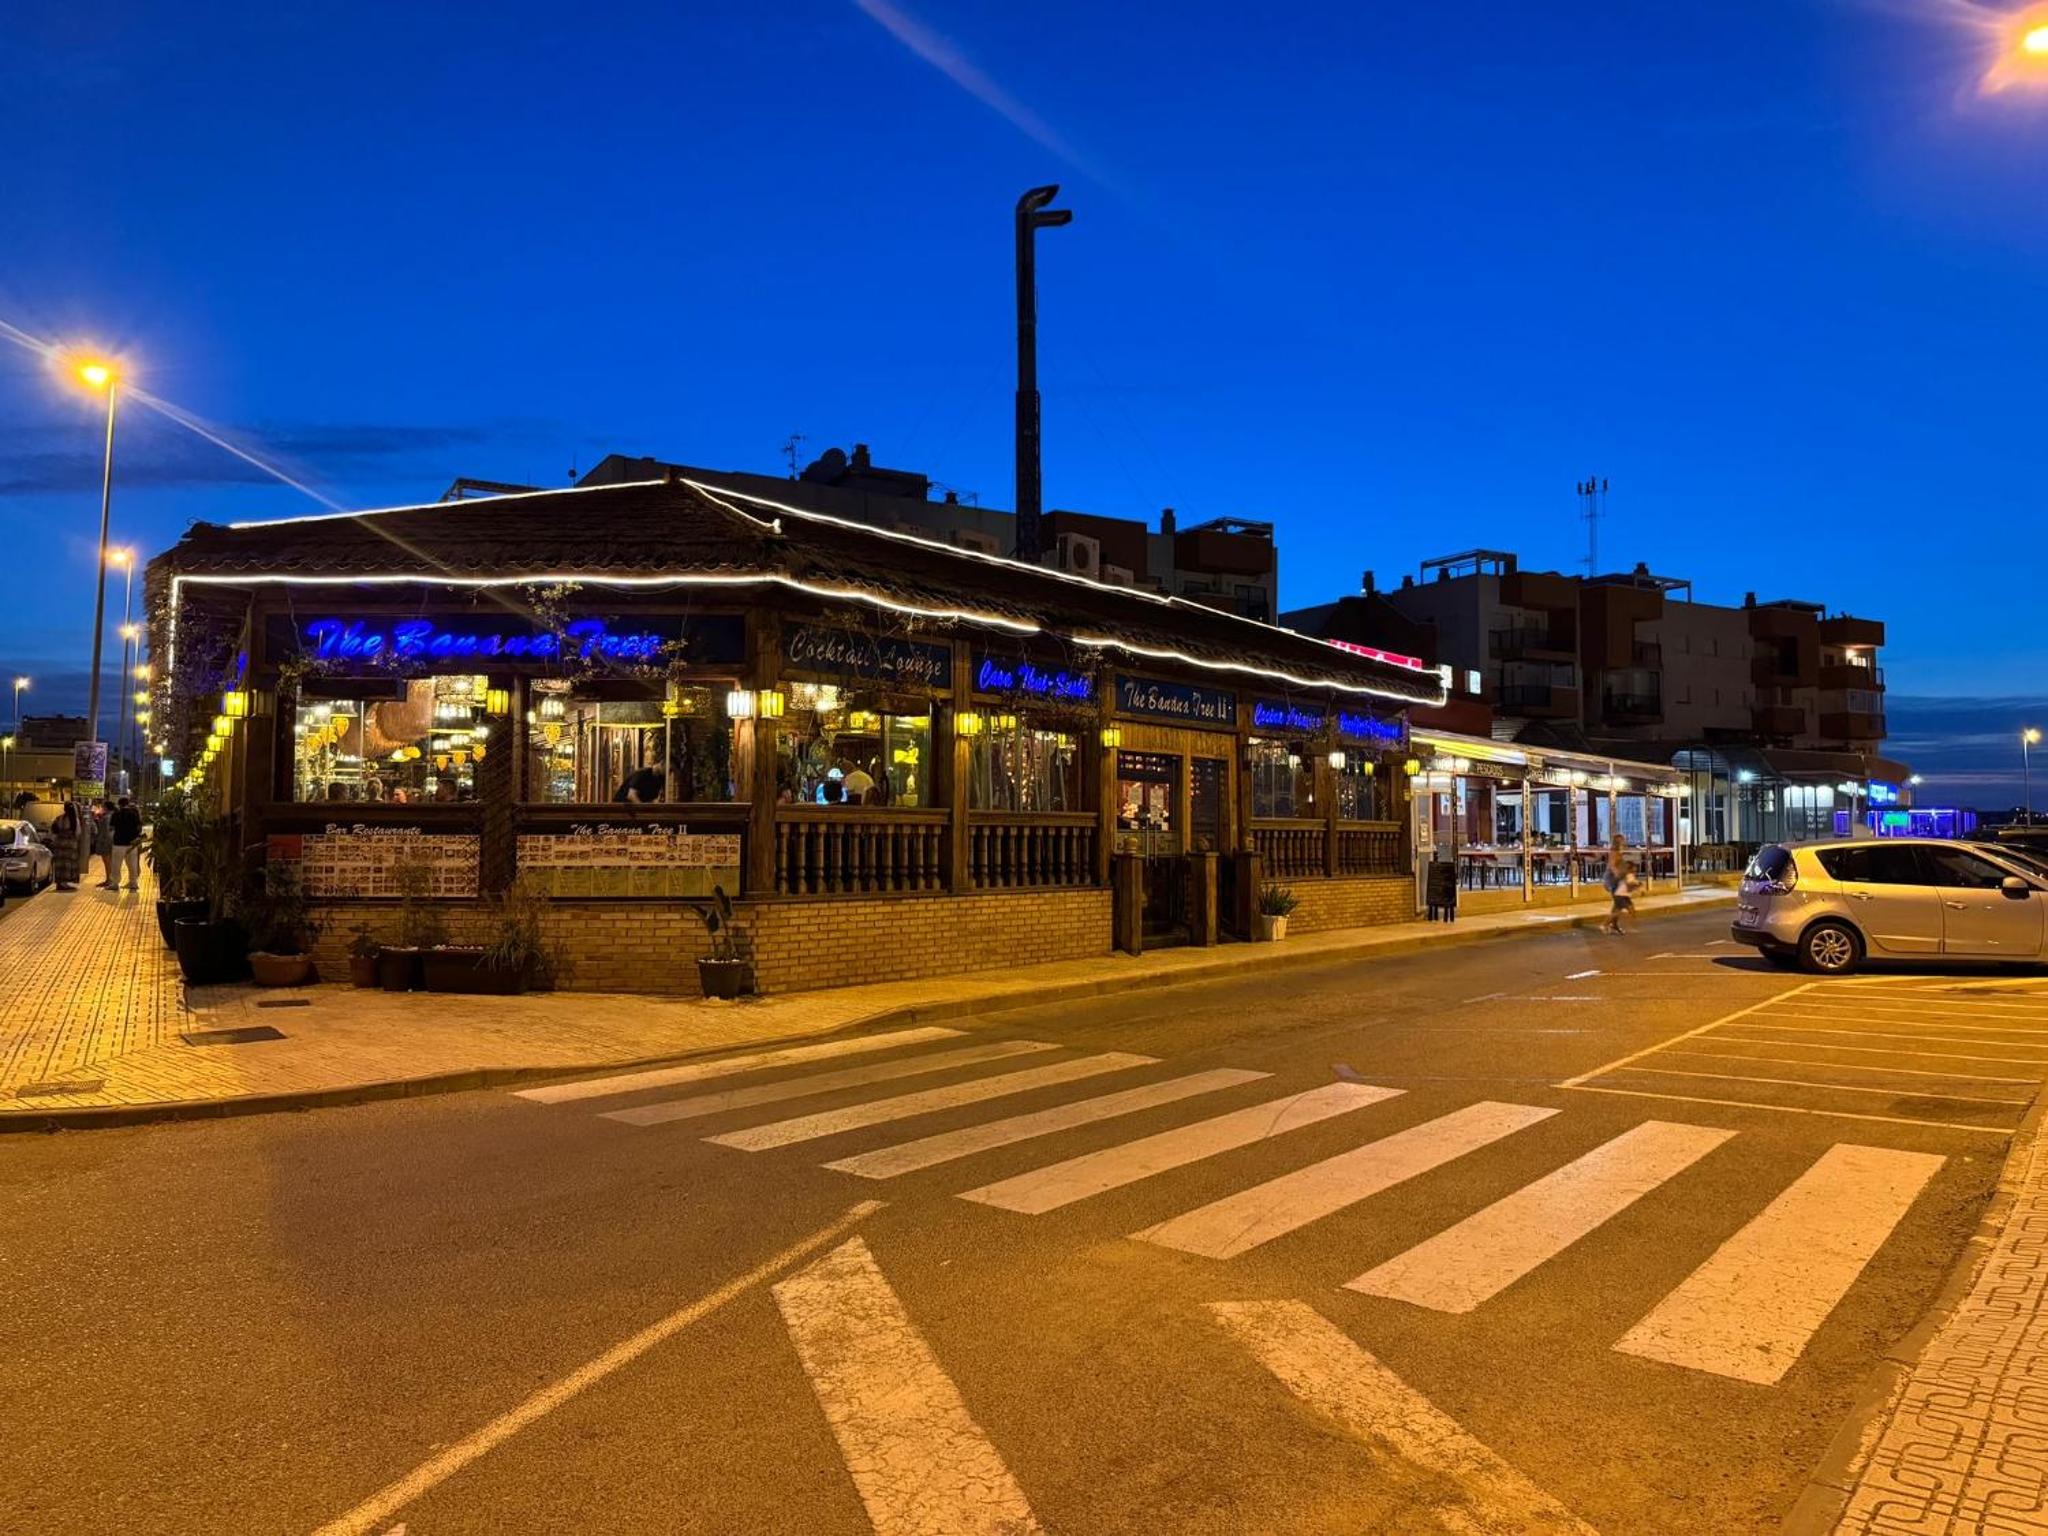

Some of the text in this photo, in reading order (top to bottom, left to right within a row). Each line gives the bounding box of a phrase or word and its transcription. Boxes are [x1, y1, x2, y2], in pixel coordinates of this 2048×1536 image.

[307, 618, 663, 658] The Banana Tree
[790, 631, 941, 681] Cocktail Lounge
[1124, 682, 1145, 708] The
[1148, 686, 1190, 714] Banana
[1192, 691, 1215, 717] Tree
[325, 823, 422, 836] Bar Restaurante
[570, 824, 688, 836] The Banana Tree II
